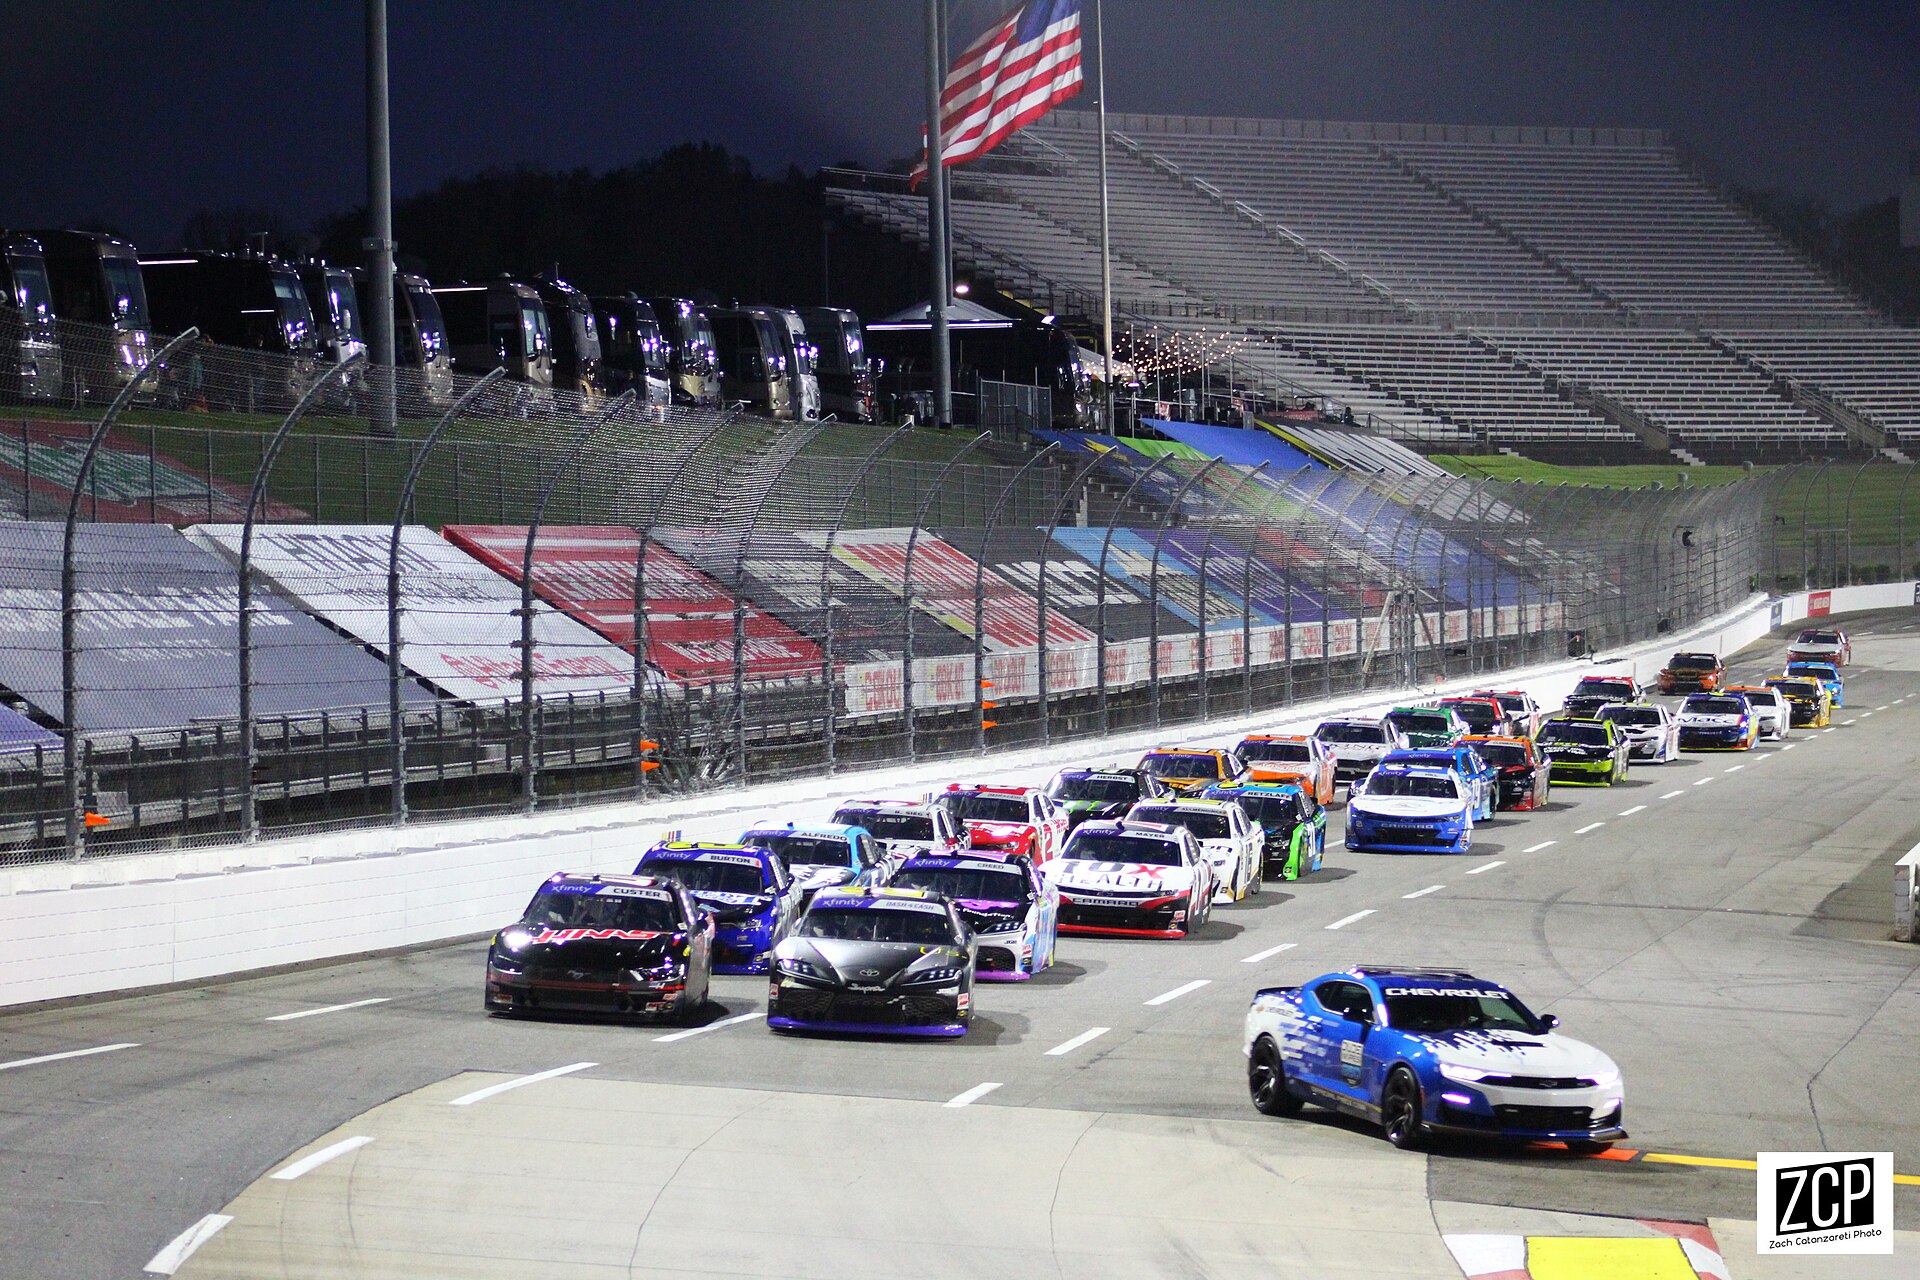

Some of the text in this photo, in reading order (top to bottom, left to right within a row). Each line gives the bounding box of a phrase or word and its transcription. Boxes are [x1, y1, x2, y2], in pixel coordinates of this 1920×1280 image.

[260, 533, 441, 572] HITACHI
[996, 561, 1142, 609] NOCO
[801, 832, 848, 841] ALFREDO
[656, 851, 692, 859] xfinity
[710, 855, 751, 864] BURTON
[914, 858, 950, 867] xfinity
[551, 884, 592, 894] xfinity
[613, 888, 662, 898] CUSTER
[821, 899, 864, 908] xfinity
[1073, 898, 1139, 906] CAMARO
[531, 929, 665, 944] HAAS
[848, 983, 885, 994] Supra
[1385, 987, 1510, 1000] CHEVROLET
